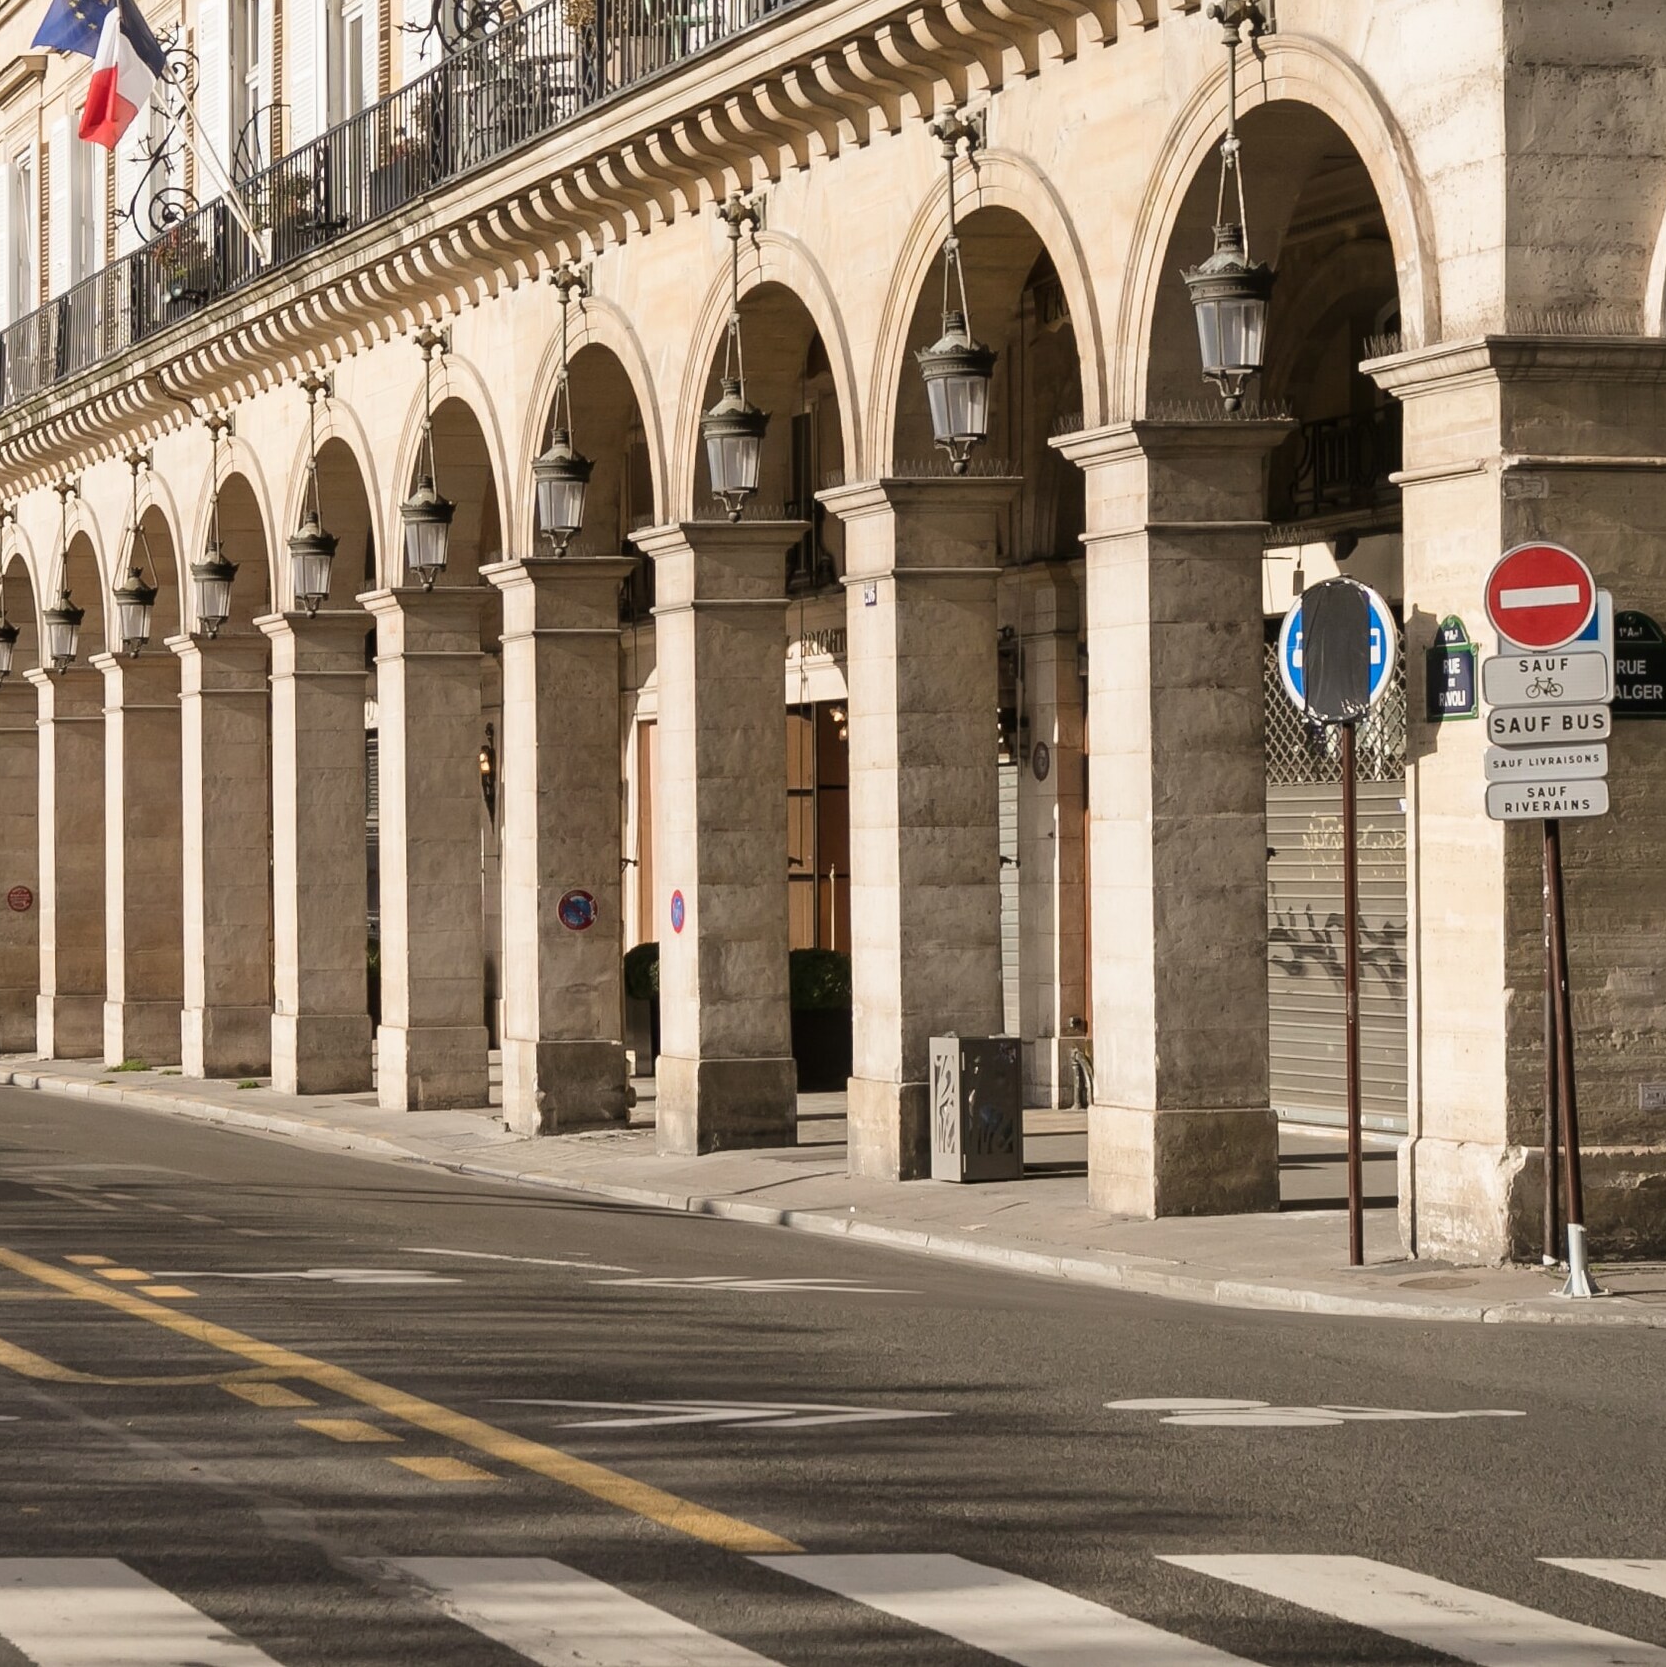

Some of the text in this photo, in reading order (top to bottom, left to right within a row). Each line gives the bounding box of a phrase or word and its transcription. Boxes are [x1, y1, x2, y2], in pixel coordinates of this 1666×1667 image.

[801, 628, 847, 657] BRIGHT
[1443, 658, 1461, 675] RUE
[1519, 657, 1569, 673] SAUF
[1616, 659, 1647, 675] RUE
[1438, 690, 1466, 707] RIVOLI
[1613, 684, 1664, 700] ALGER
[1494, 713, 1605, 734] SAUF BUS
[1493, 753, 1600, 769] SAUF LIVRAISONS
[1527, 786, 1568, 798] SAUF
[1505, 799, 1591, 813] RIVERAINS
